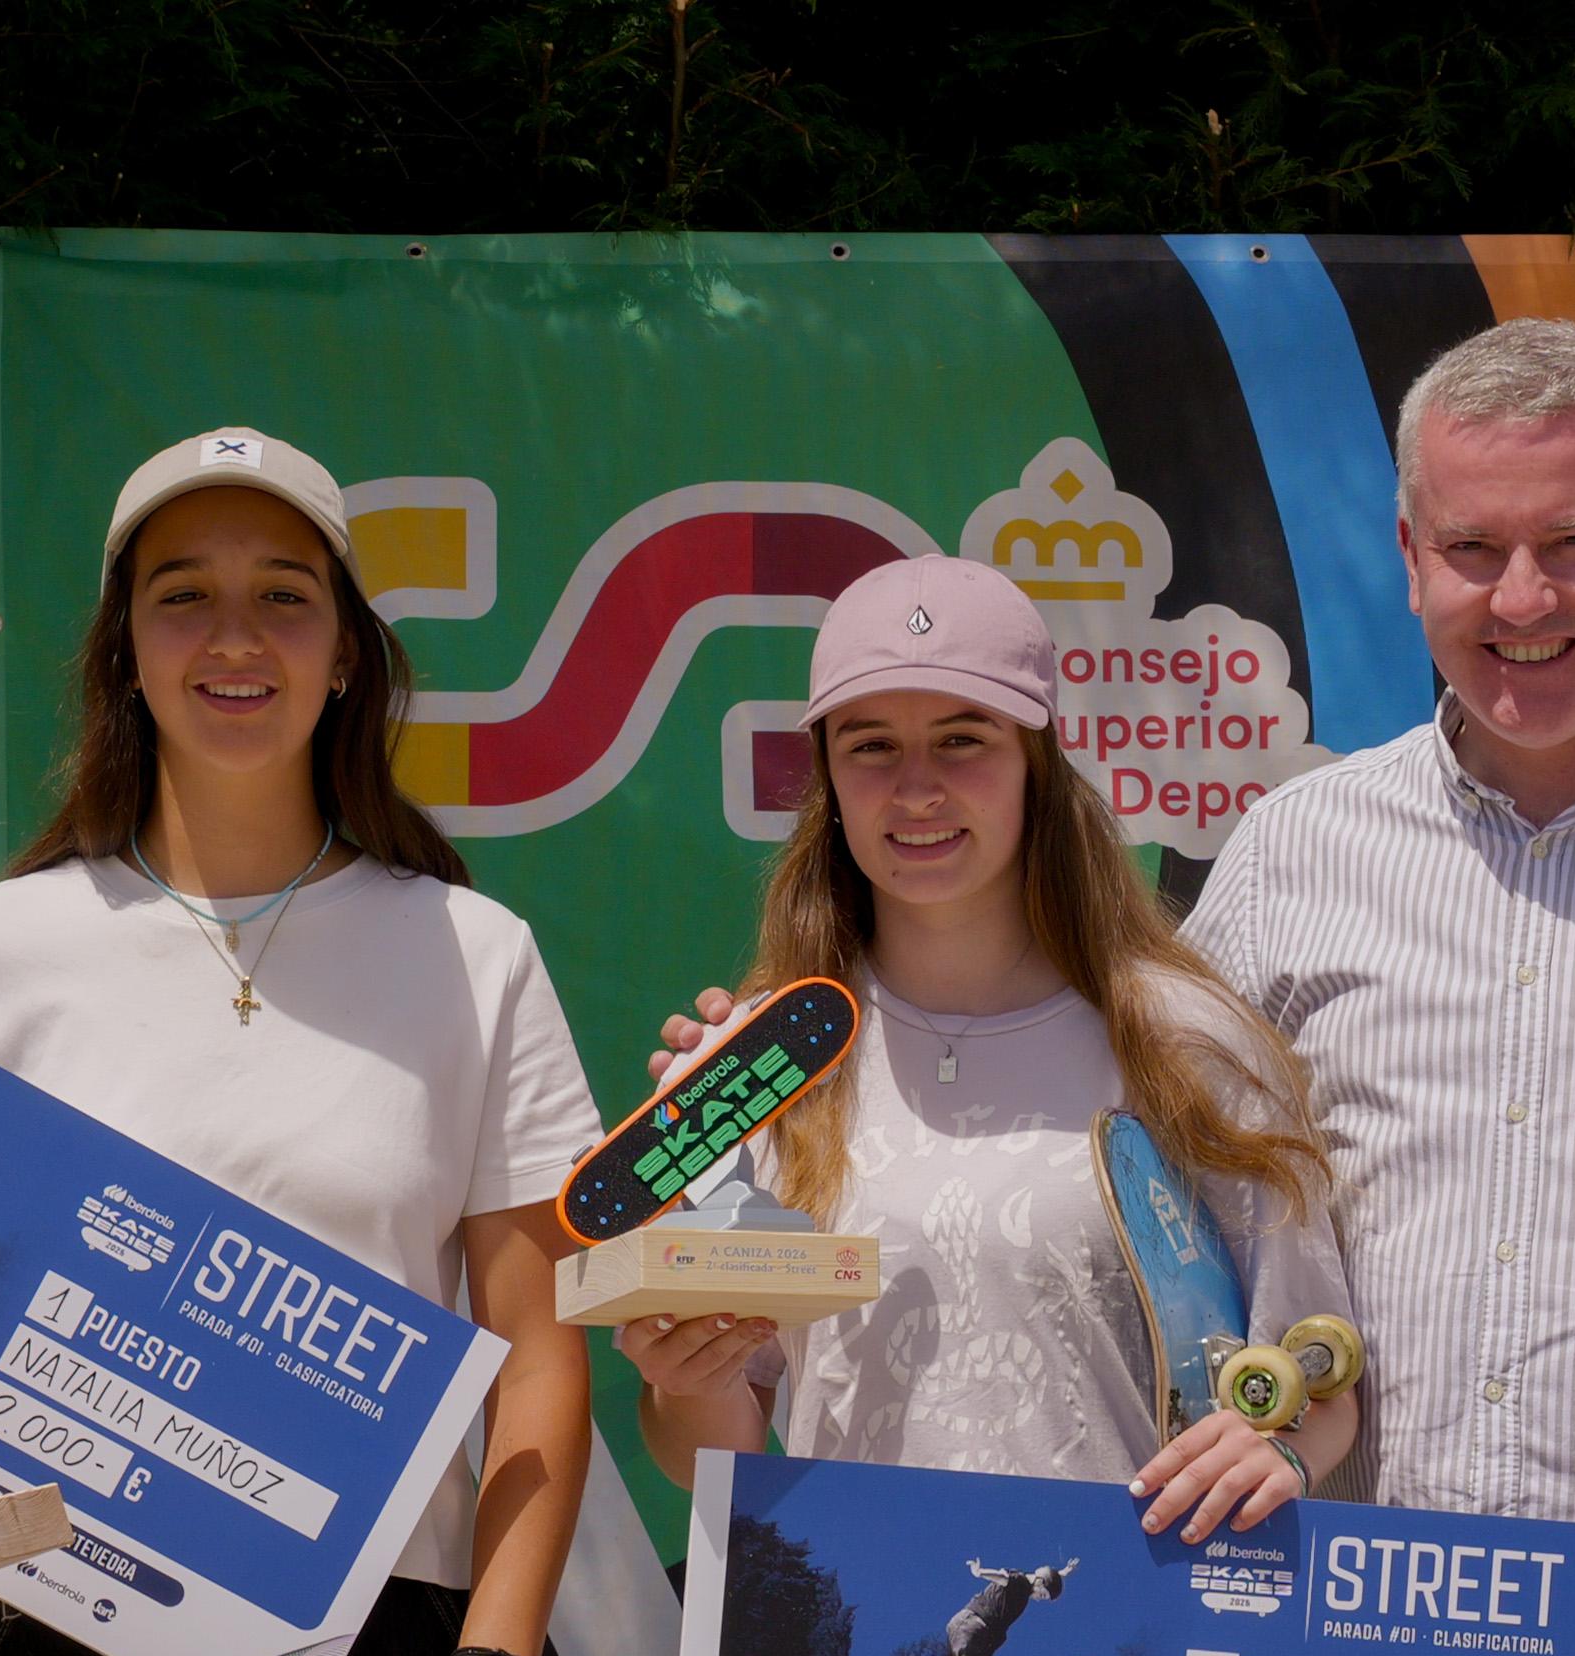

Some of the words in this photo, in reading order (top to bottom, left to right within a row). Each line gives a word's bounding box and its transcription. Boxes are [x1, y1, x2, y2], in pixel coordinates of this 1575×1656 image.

[1059, 634, 1260, 697] onsejo
[1058, 701, 1279, 762] uperior
[1112, 768, 1273, 829] Depo
[675, 1055, 740, 1109] Iberdrola
[633, 1044, 789, 1182] SKATE
[651, 1064, 806, 1202] SERIES
[77, 1207, 169, 1263] SERIES
[83, 1196, 175, 1252] SKATE
[124, 1194, 175, 1230] Iberdrola
[720, 1261, 773, 1273] clasificada
[785, 1263, 817, 1275] Street
[723, 1247, 772, 1259] CANIZA
[777, 1248, 807, 1260] 2026
[835, 1270, 861, 1280] CNS
[43, 1288, 70, 1323] 1
[193, 1229, 428, 1393] STREET
[79, 1304, 201, 1391] PUESTO
[178, 1299, 232, 1340] PARADA
[275, 1352, 384, 1422] CLASIFICATORIA
[10, 1337, 143, 1432] NATALIA
[153, 1414, 285, 1504] MUÑOZ
[70, 1531, 137, 1582] TEVEDRA
[1191, 1563, 1293, 1583] SKATE
[1229, 1545, 1285, 1562] Iberdrola
[36, 1571, 86, 1605] Iberdrola
[1190, 1577, 1293, 1596] SERIES
[1325, 1535, 1565, 1628] STREET
[1323, 1620, 1382, 1641] PARADA
[1433, 1629, 1554, 1656] CLASIFICATORIA
